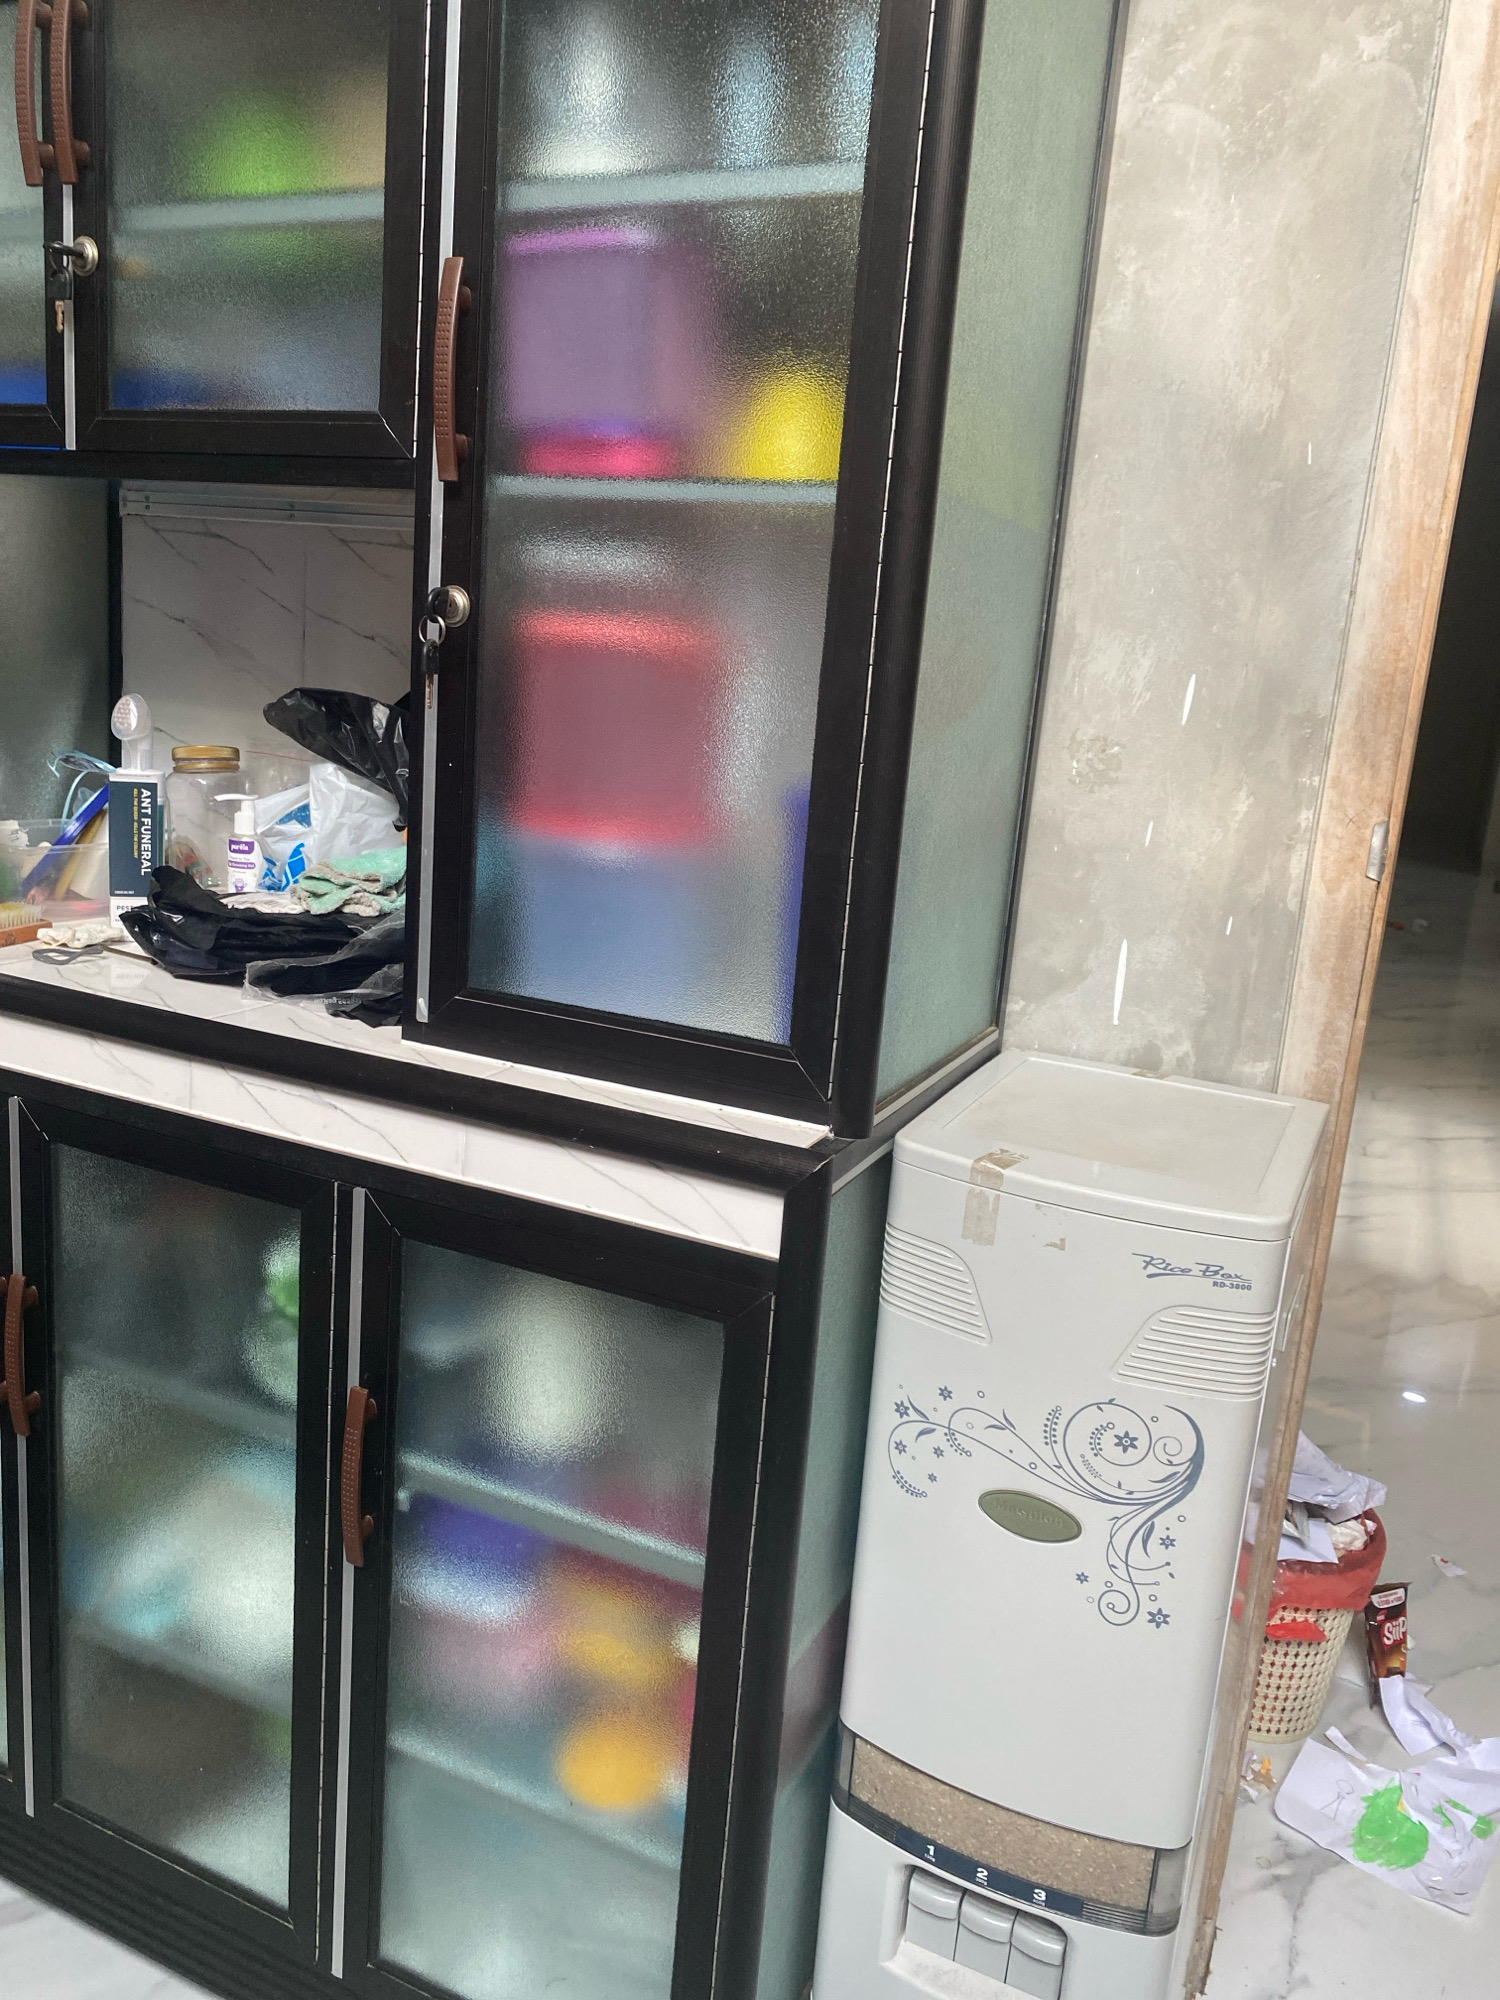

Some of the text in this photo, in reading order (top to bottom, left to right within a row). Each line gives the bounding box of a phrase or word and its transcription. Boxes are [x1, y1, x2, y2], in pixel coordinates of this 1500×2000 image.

[141, 788, 152, 876] ANT FUNERAL
[1131, 1252, 1252, 1281] Rice Box
[1212, 1281, 1252, 1291] RD-3800
[927, 1845, 935, 1856] 1
[976, 1867, 989, 1881] 2
[1032, 1889, 1047, 1901] 3
